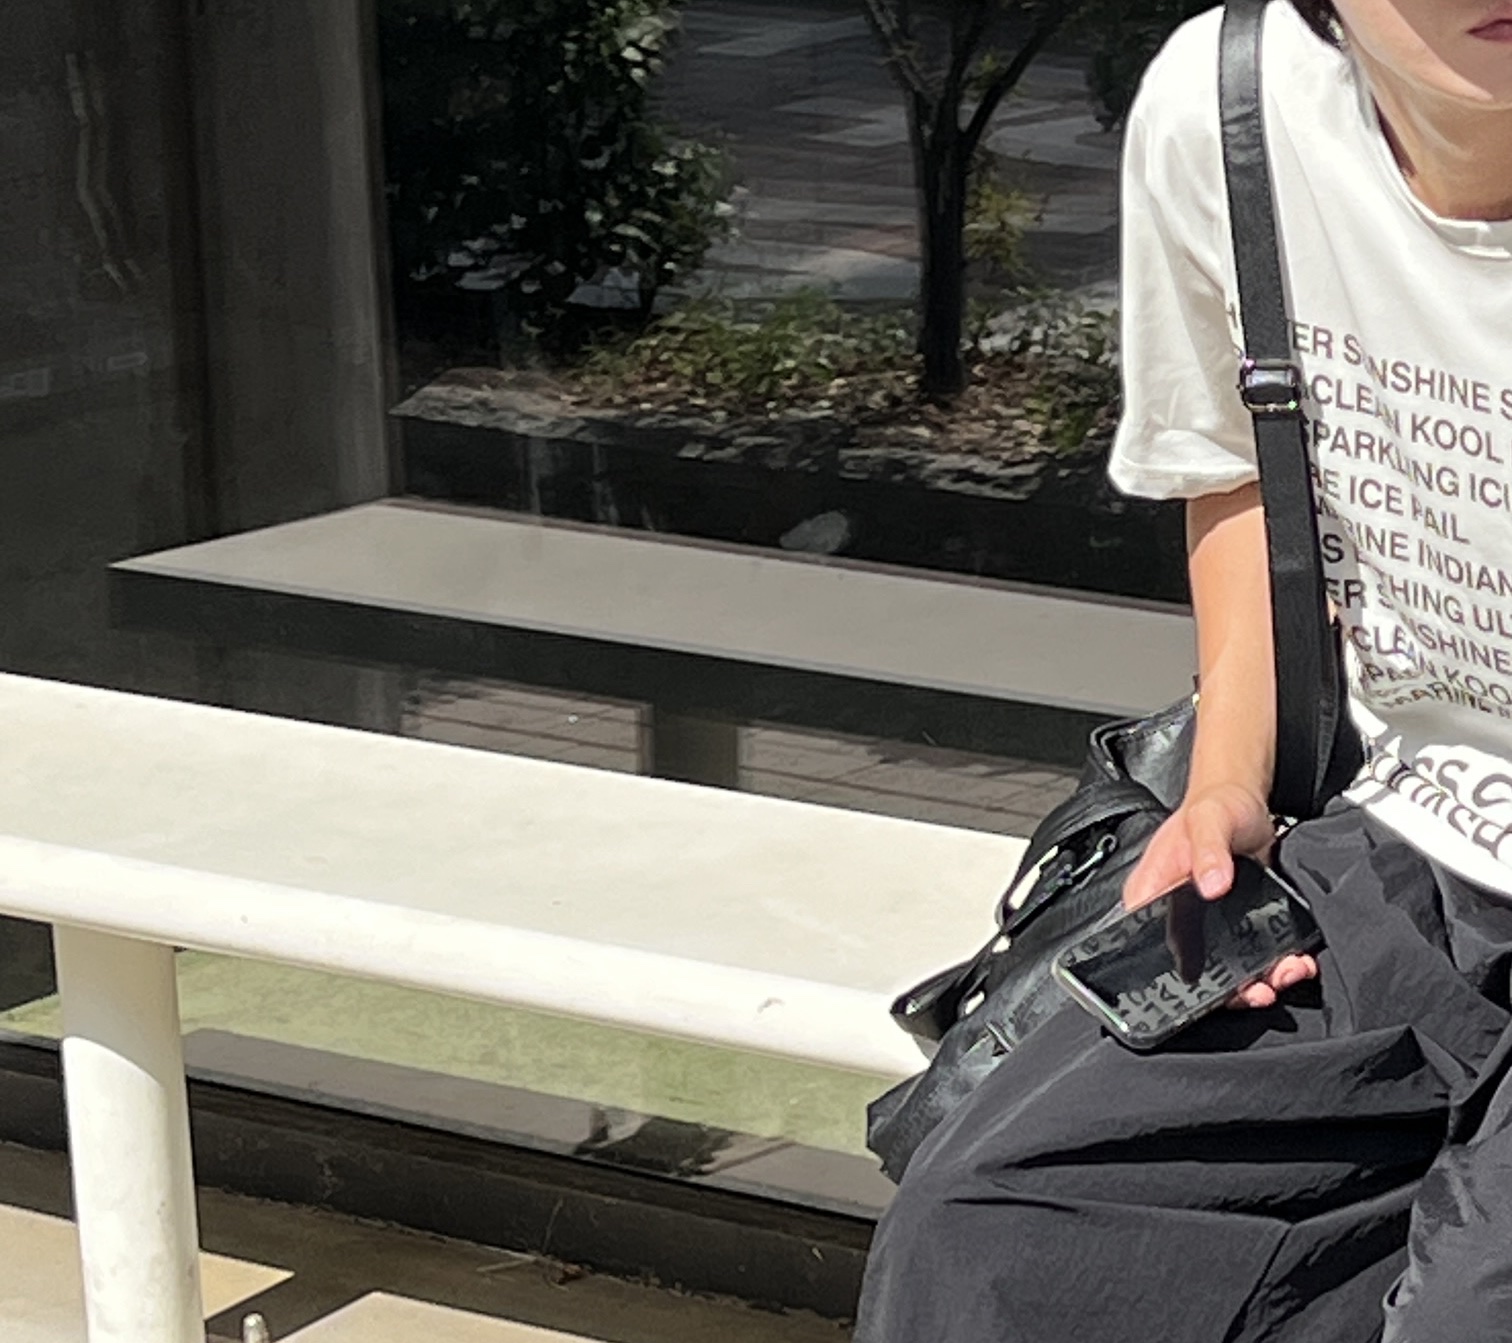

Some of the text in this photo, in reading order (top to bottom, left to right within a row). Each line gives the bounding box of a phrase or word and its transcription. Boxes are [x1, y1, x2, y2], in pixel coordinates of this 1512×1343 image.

[1343, 333, 1492, 414] SNSHINE
[1410, 412, 1504, 464] KOOL
[1349, 475, 1404, 517] ICE
[1411, 493, 1471, 546] PAIL
